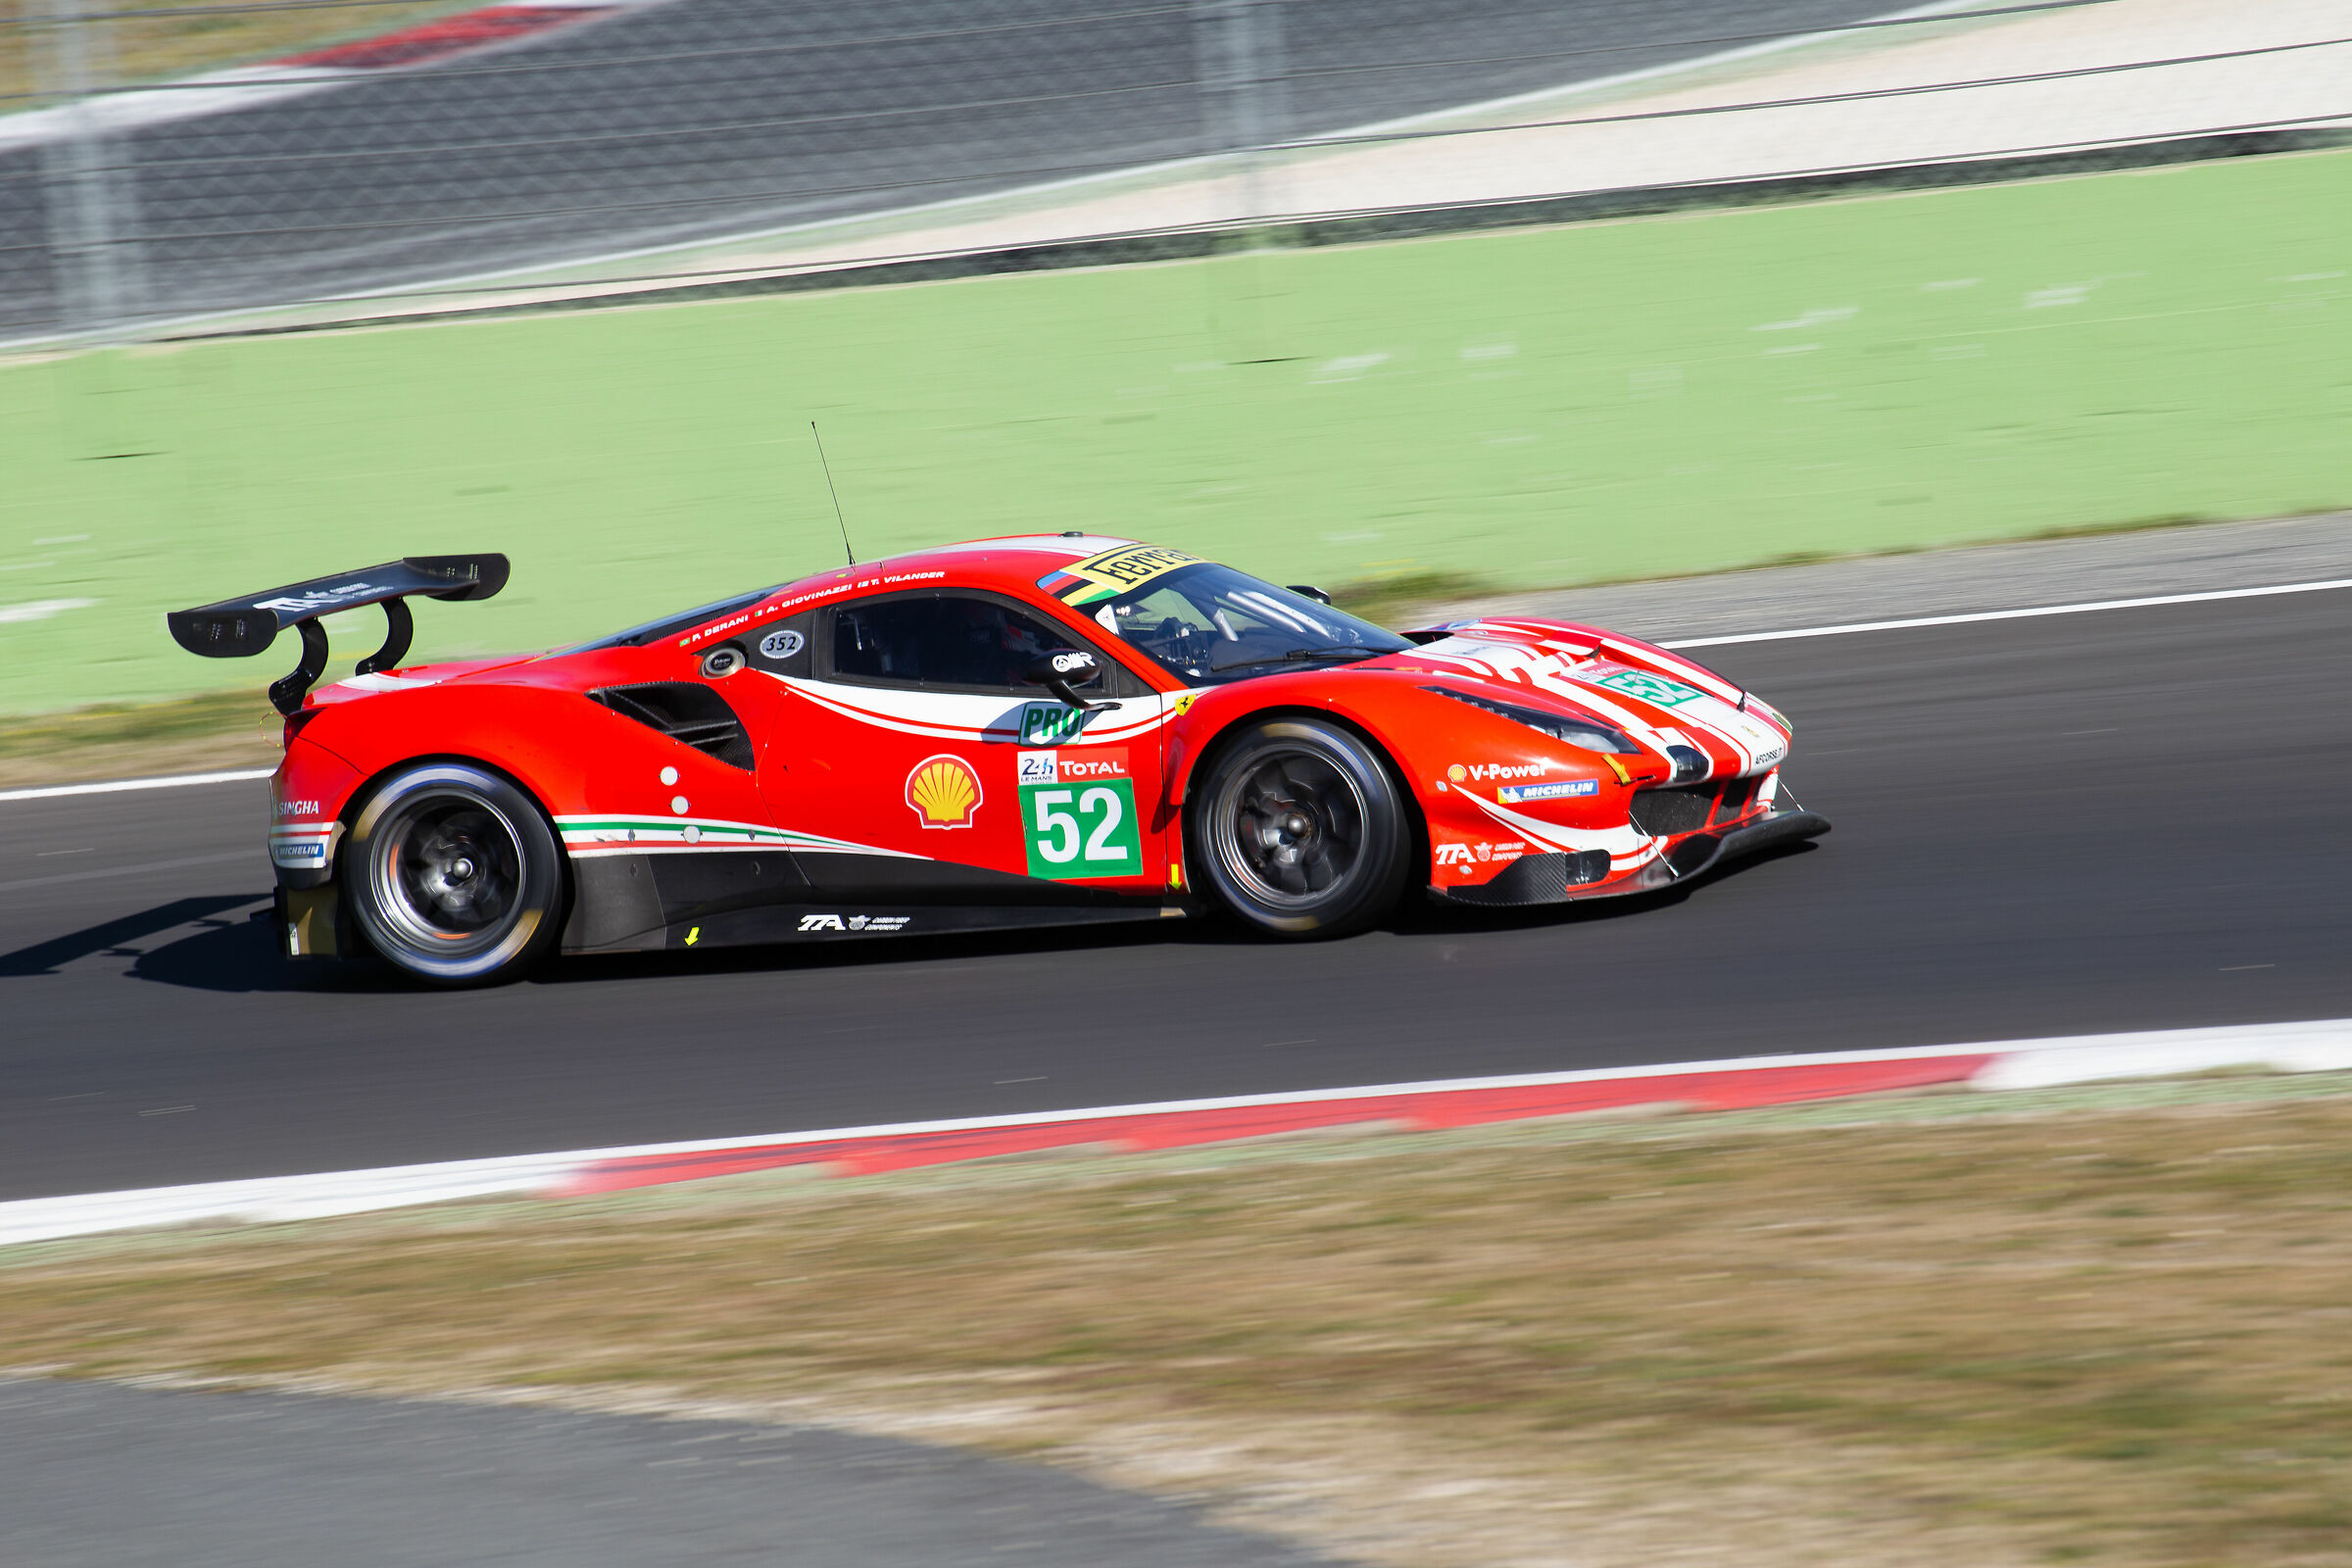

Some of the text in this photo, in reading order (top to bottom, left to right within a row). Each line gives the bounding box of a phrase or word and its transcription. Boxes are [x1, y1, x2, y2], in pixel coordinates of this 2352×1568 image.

[884, 571, 946, 584] VILANDER
[766, 583, 853, 614] A. GIOVINAZZI
[705, 614, 749, 638] DERANI
[765, 635, 797, 652] 352
[1604, 671, 1697, 704] 52
[1023, 707, 1082, 738] PRO
[1469, 762, 1546, 781] V-Power
[1523, 781, 1593, 798] MICHELIN
[279, 800, 319, 816] SINGHA
[1035, 787, 1128, 863] 52
[279, 844, 319, 857] MICHELIN
